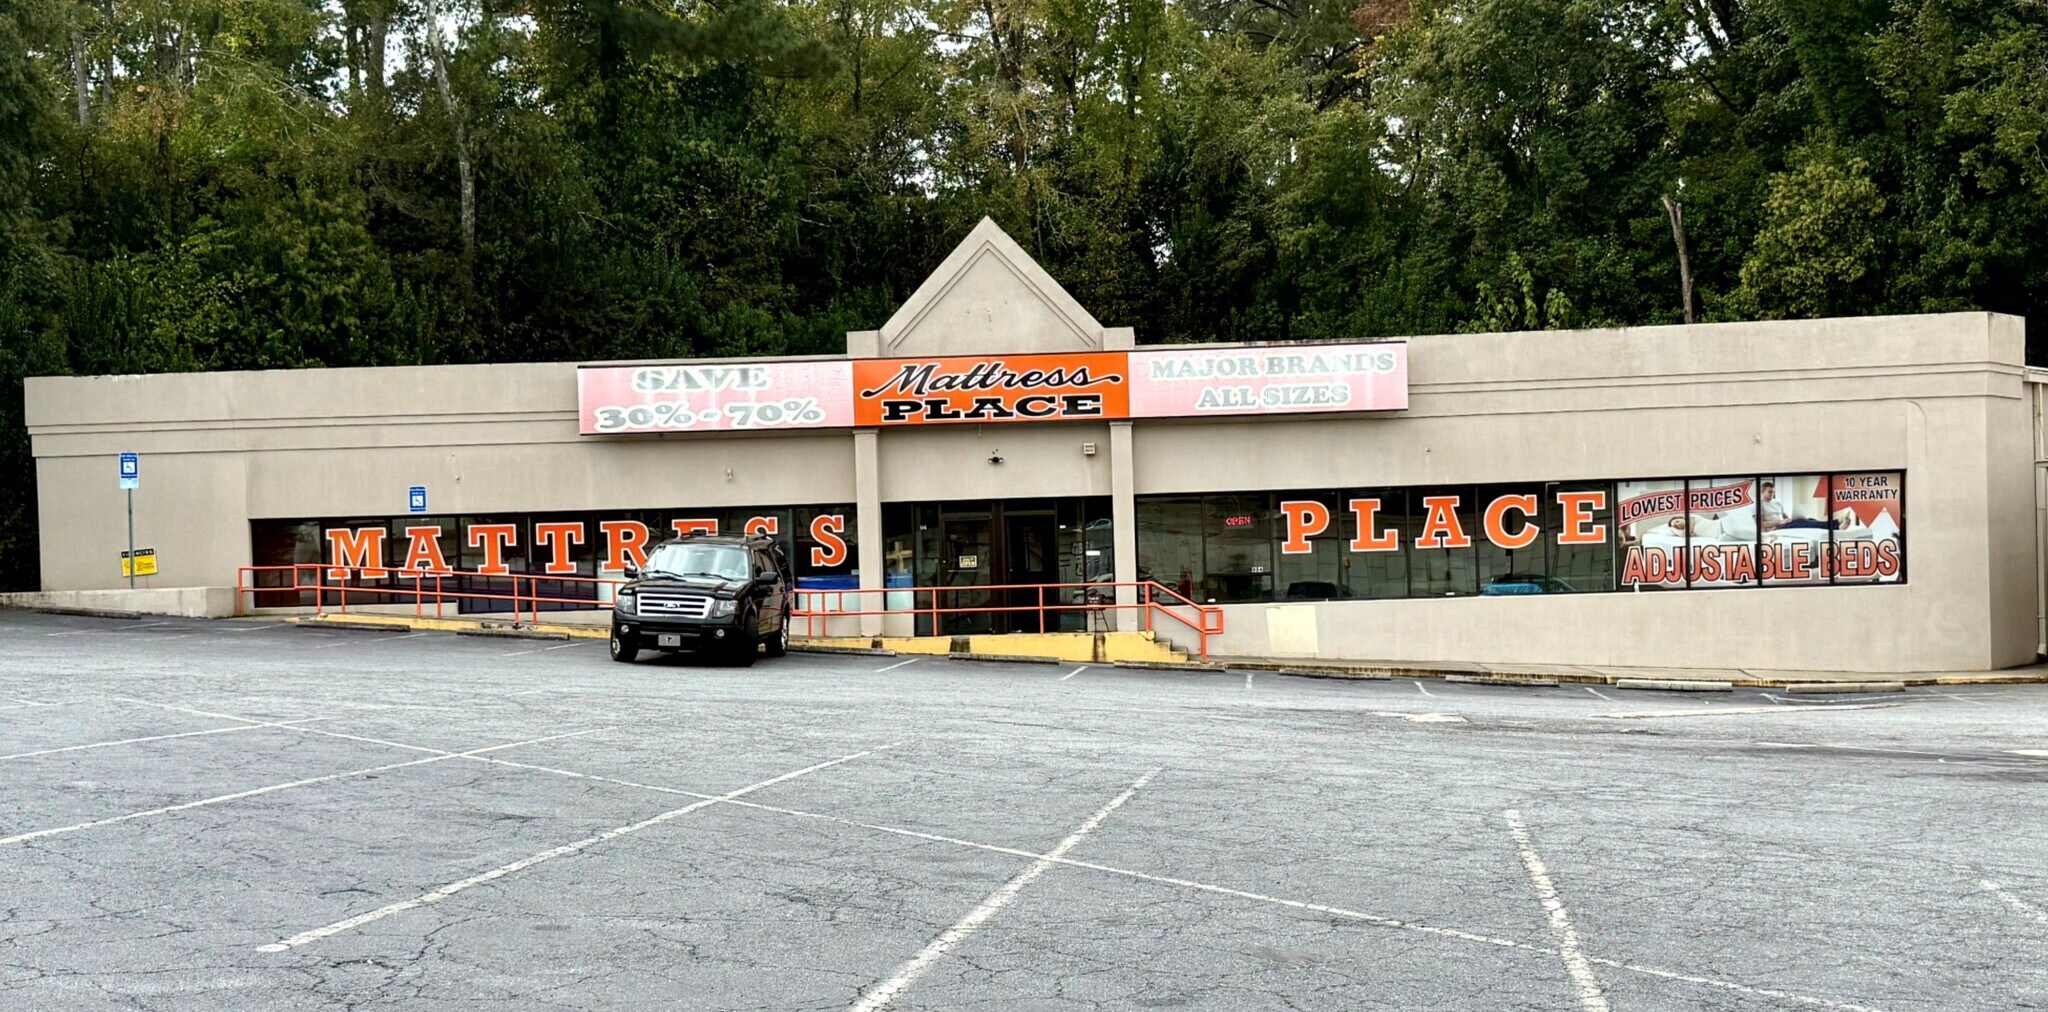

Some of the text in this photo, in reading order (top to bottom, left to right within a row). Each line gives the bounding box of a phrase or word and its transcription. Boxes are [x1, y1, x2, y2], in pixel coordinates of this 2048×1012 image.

[634, 367, 769, 392] SAVE
[1150, 352, 1396, 381] MAJOR BRANDS
[861, 362, 1121, 399] Mattress
[881, 396, 1102, 422] PLACE
[1196, 383, 1351, 409] ALL SIZES
[1835, 487, 1899, 502] WARRANTY
[1845, 475, 1888, 488] 10 YEAR
[1620, 487, 1743, 521] LOWEST PRICES
[1225, 516, 1251, 526] OPEN
[1280, 491, 1607, 555] PLACE
[325, 513, 848, 580] MATTRS
[1621, 538, 1901, 586] ADJUSTABLE BEDS
